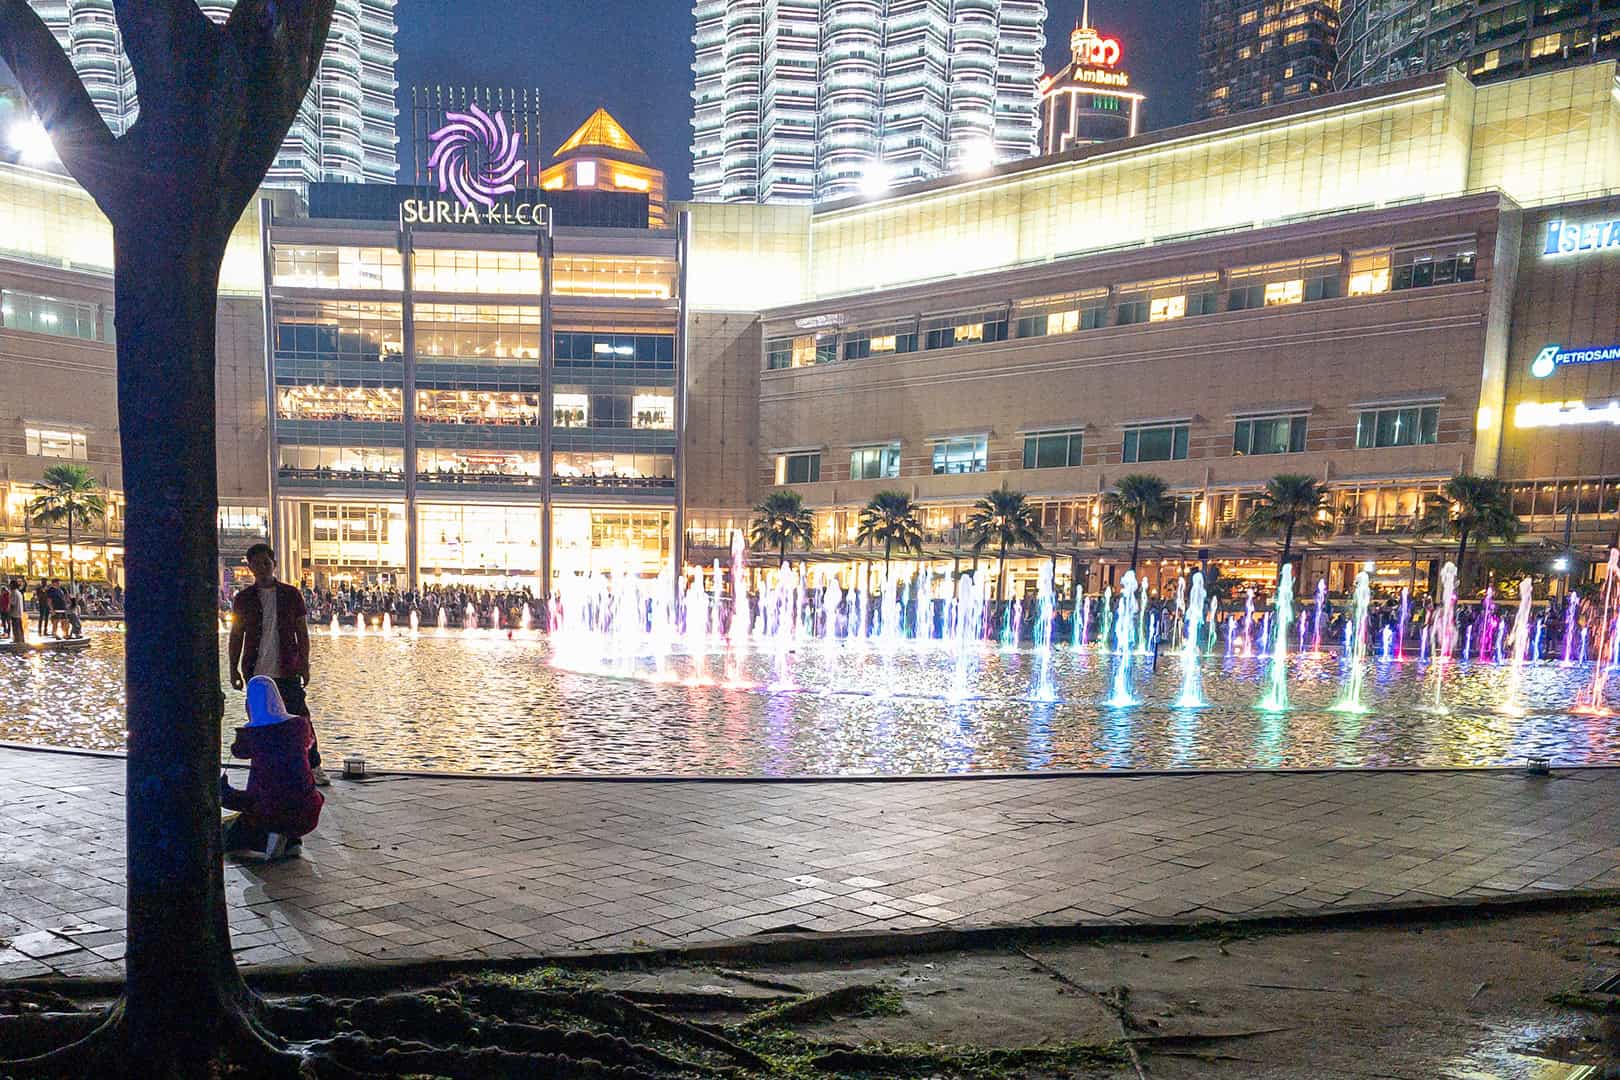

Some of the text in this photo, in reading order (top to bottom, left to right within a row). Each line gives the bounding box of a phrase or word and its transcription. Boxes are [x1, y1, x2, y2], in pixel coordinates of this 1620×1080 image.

[1074, 68, 1129, 86] AmBank
[403, 199, 548, 225] SURIA KLCC
